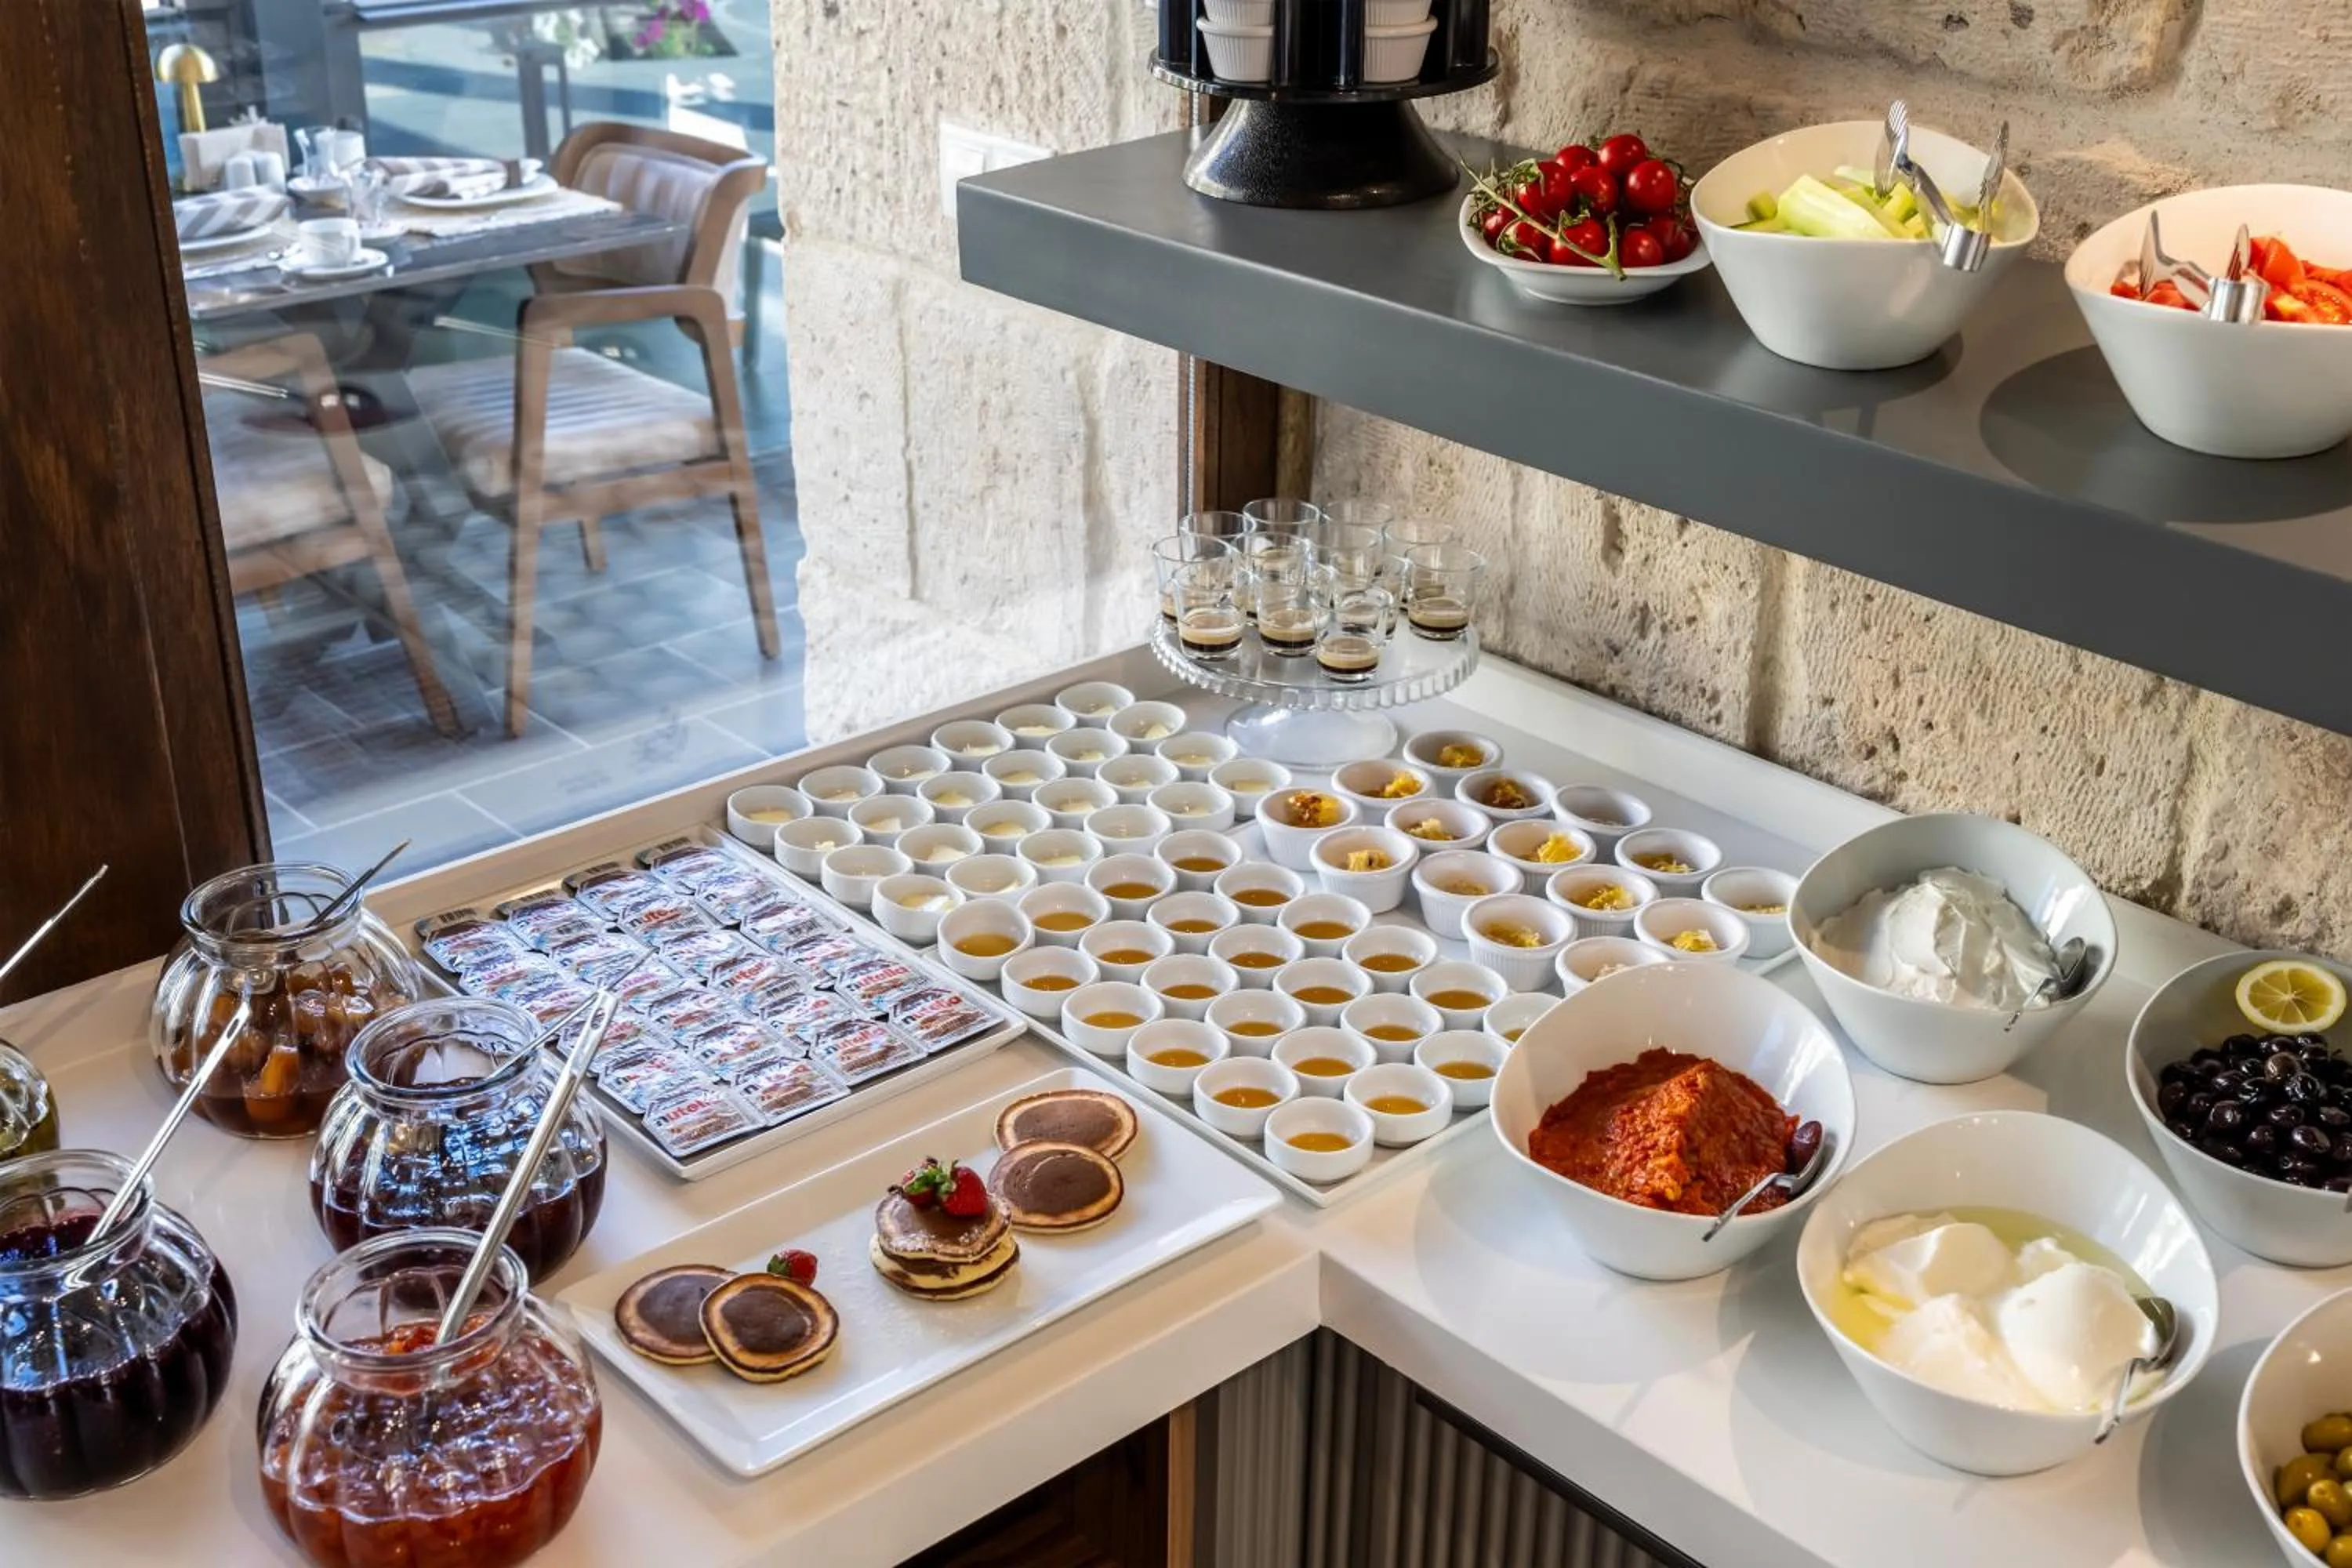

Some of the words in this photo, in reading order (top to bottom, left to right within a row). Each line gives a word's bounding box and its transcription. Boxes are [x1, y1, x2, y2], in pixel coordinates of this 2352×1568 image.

[846, 966, 911, 992] nutella
[824, 1027, 888, 1055] nutella
[655, 1098, 722, 1127] nutel
